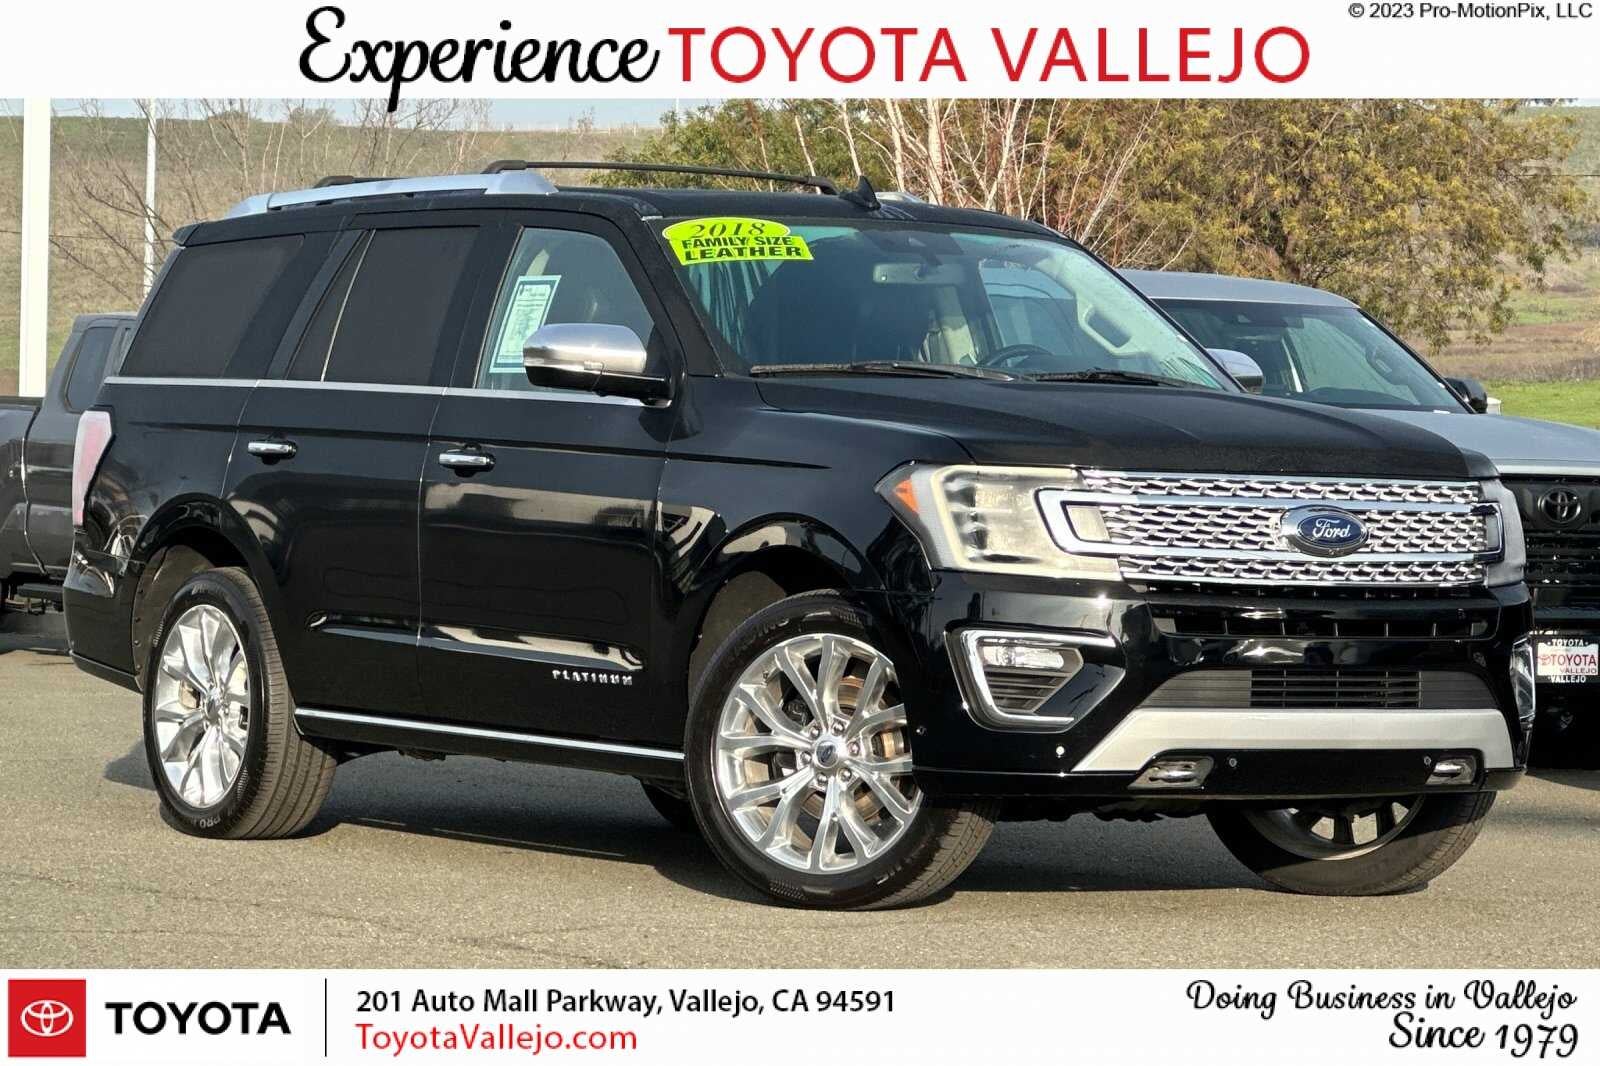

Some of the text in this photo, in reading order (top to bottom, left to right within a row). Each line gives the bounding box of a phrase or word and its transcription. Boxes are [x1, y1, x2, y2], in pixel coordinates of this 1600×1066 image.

[689, 222, 766, 238] 2018
[682, 236, 792, 249] FAMILY SIZE
[685, 247, 801, 260] LEATHER
[1312, 518, 1351, 538] Ford
[1551, 638, 1584, 647] TOYOTA
[1551, 654, 1597, 666] TOYOTA
[552, 669, 633, 686] PLATINUM
[1551, 674, 1586, 683] VALLEJO
